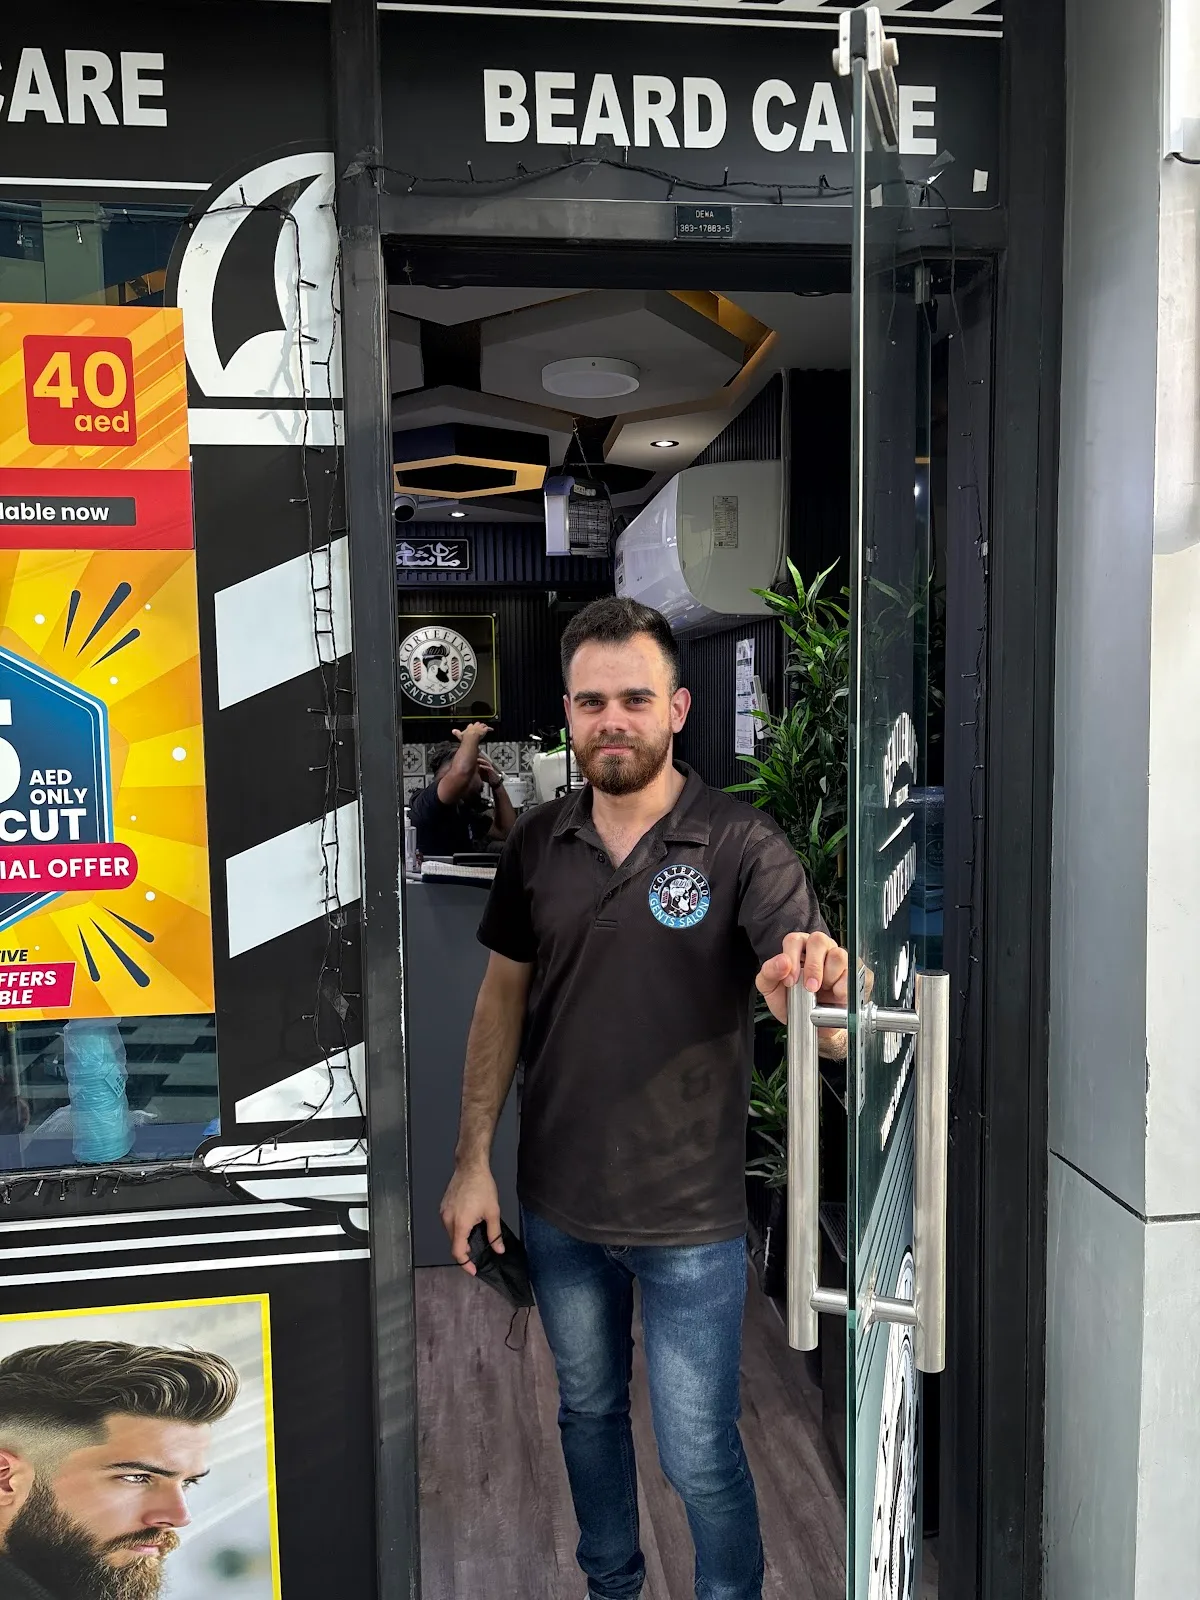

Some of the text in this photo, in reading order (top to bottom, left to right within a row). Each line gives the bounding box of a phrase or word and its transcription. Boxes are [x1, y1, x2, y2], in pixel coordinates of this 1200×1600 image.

[0, 47, 168, 127] ARE
[483, 69, 937, 155] BEARD CAE
[695, 209, 714, 218] DEWA
[32, 350, 127, 409] 40
[74, 410, 130, 433] aed
[61, 507, 109, 521] now
[400, 629, 473, 663] CORTEFINO
[400, 671, 474, 705] GENTS SALON
[29, 769, 73, 786] AED
[29, 788, 89, 805] ONLY
[0, 808, 87, 842] CUT
[47, 857, 130, 878] OFFER
[653, 867, 709, 896] CORTEFINO
[650, 897, 709, 927] GENTS SALON
[0, 949, 29, 962] IVE
